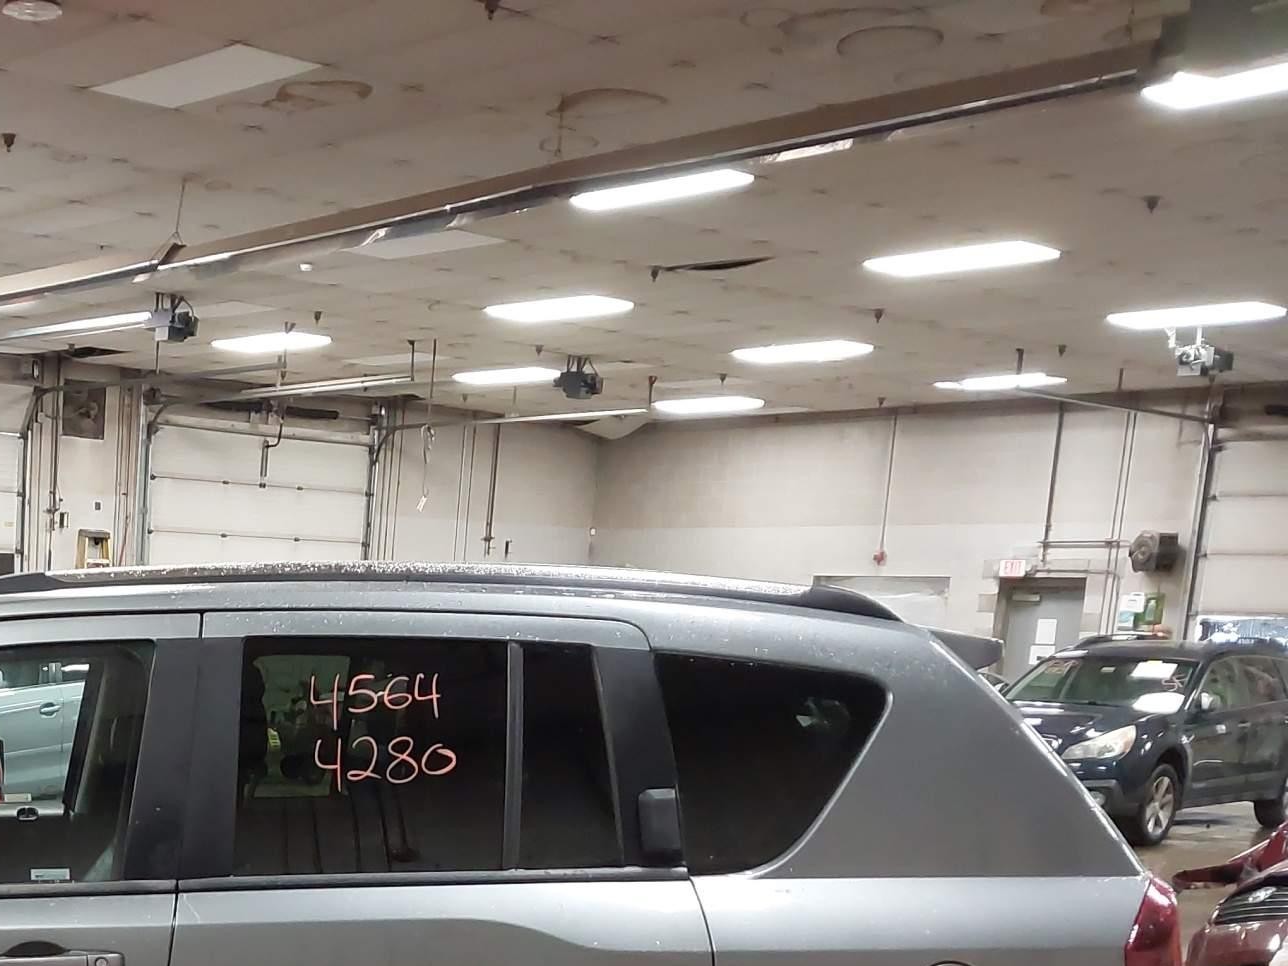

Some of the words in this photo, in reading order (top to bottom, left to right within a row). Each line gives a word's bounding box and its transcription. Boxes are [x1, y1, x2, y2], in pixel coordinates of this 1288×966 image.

[1004, 560, 1023, 575] EXIT
[310, 672, 441, 731] 4564
[314, 736, 457, 792] 4280
